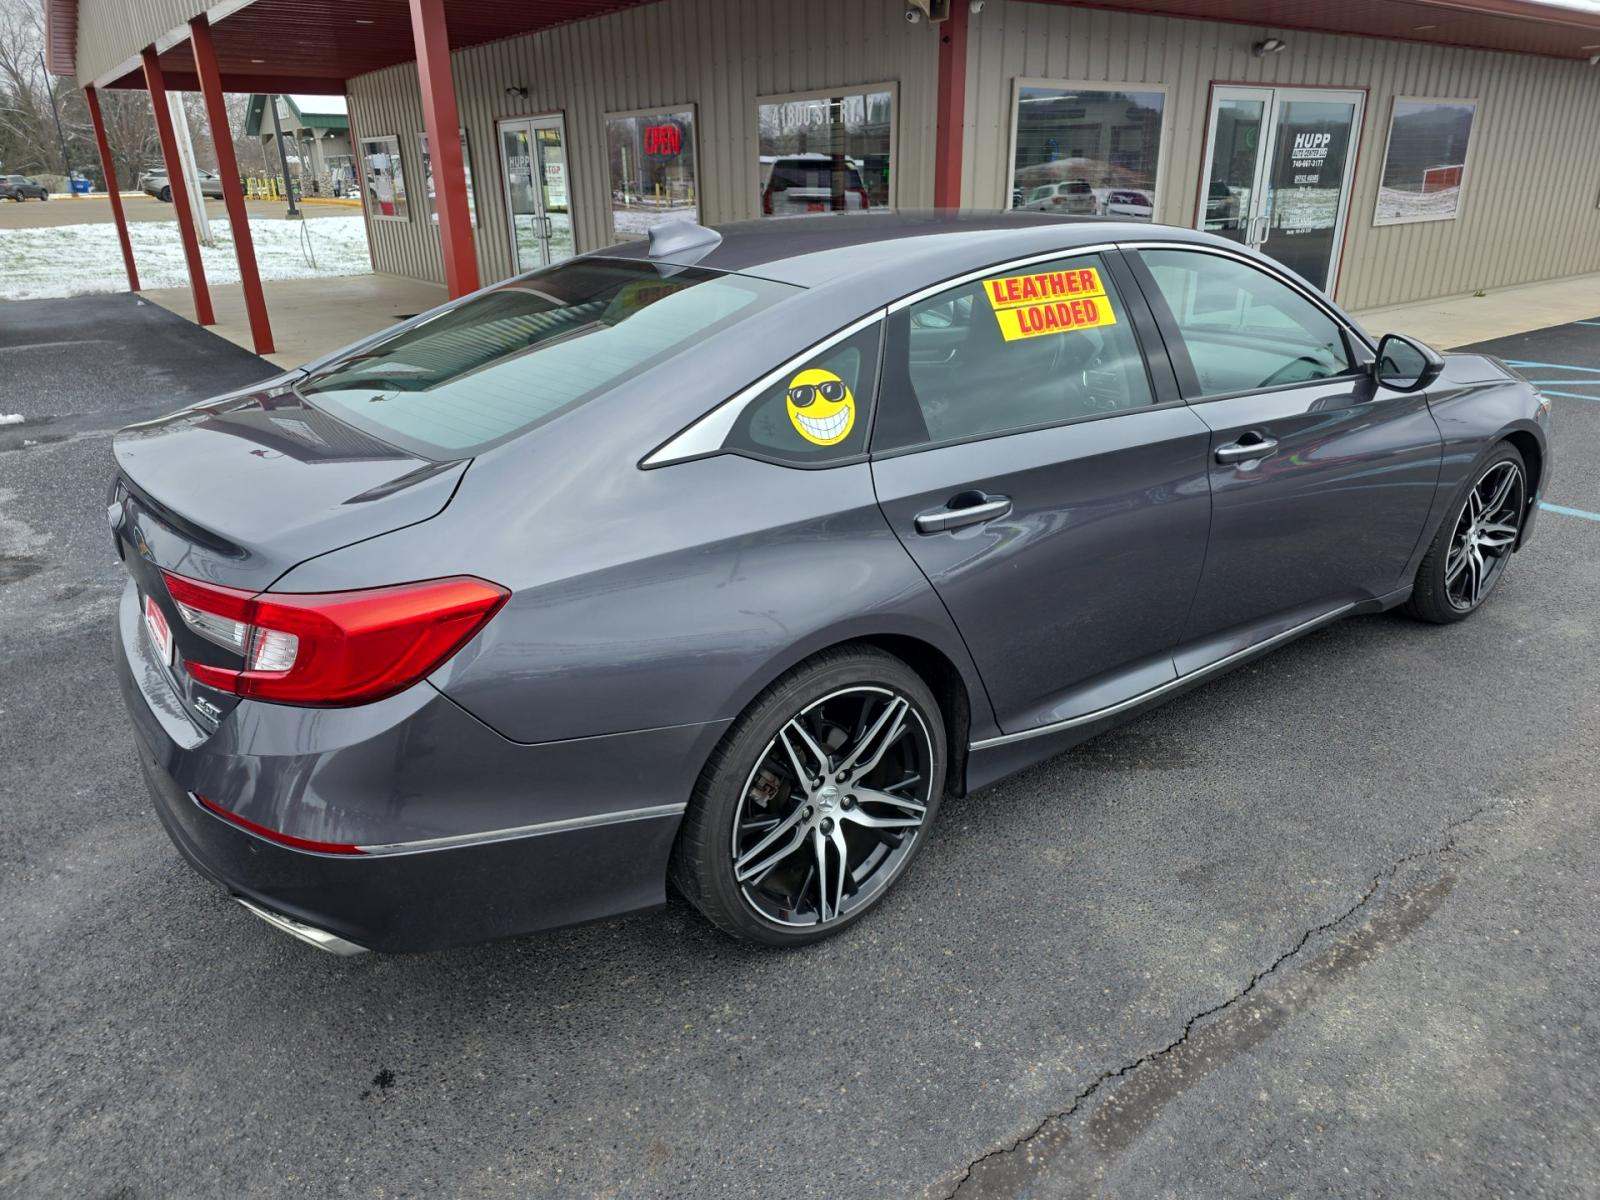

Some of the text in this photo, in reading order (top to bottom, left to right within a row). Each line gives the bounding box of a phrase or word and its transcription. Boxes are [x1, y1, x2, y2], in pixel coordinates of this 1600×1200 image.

[643, 126, 681, 155] OPEN
[1294, 132, 1331, 148] HUPP
[992, 270, 1096, 304] LEATHER
[1016, 299, 1099, 334] LOADED
